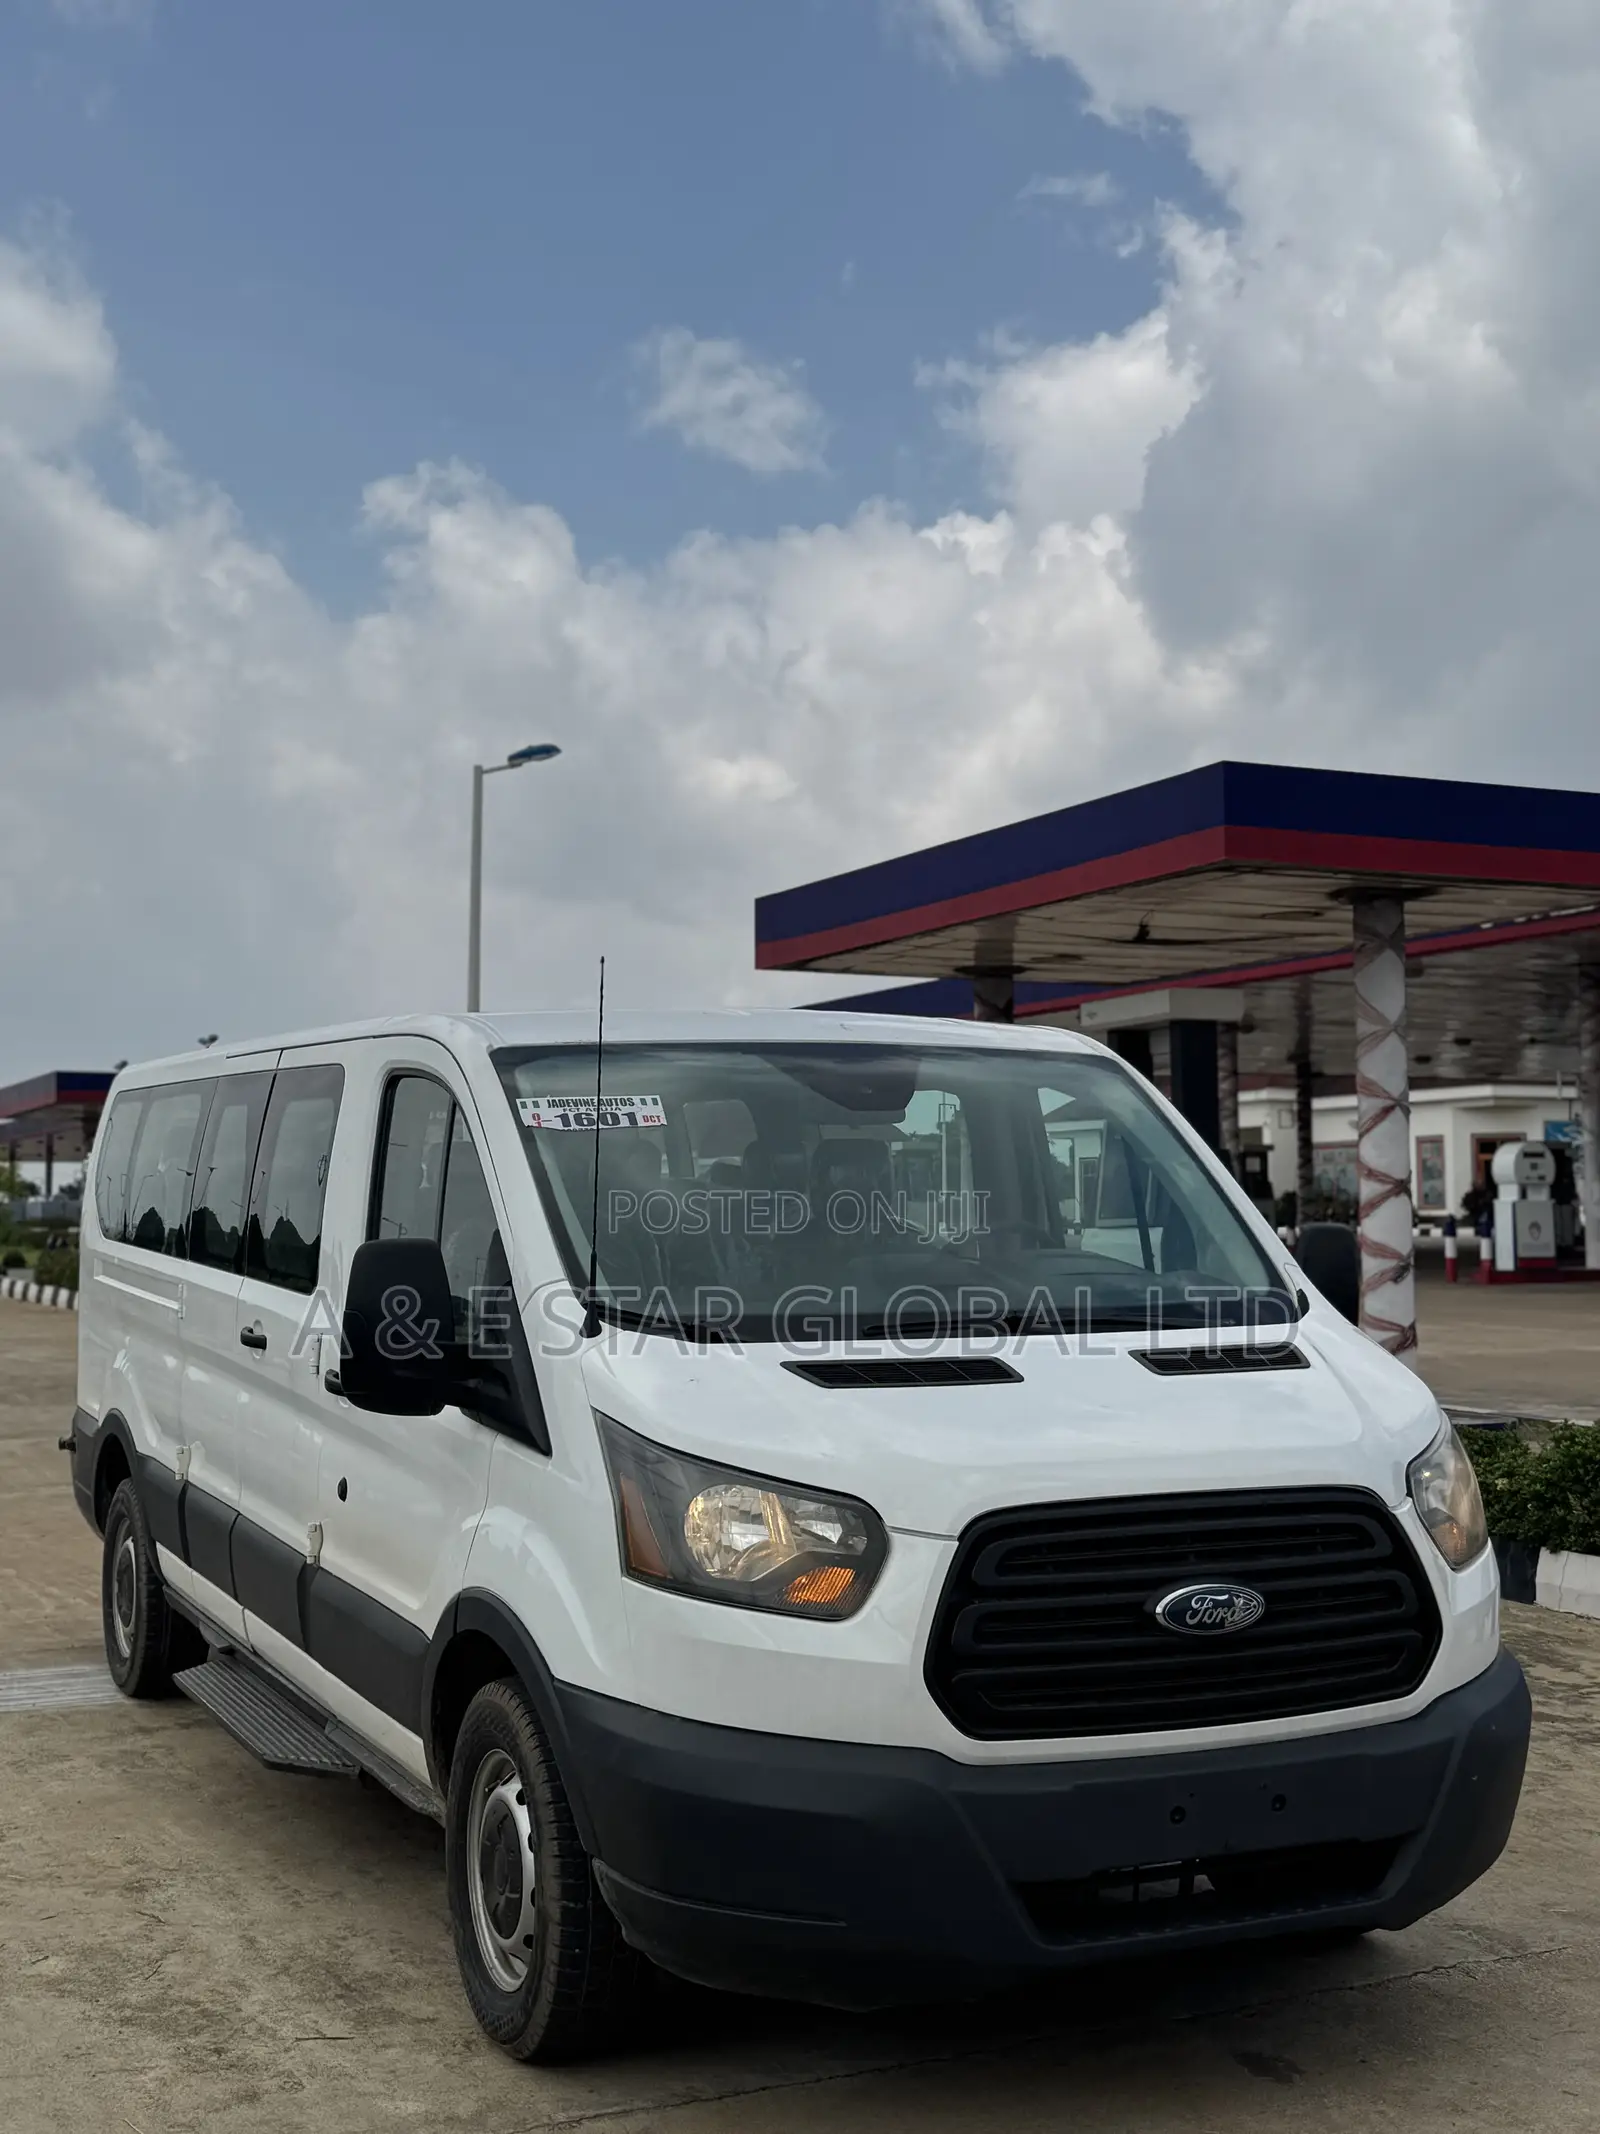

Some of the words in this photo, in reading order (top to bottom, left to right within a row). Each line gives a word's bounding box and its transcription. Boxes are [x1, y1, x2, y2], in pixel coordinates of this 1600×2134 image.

[600, 1097, 635, 1107] AUTOS
[642, 1114, 662, 1123] OCT
[1185, 1594, 1242, 1625] Ford
